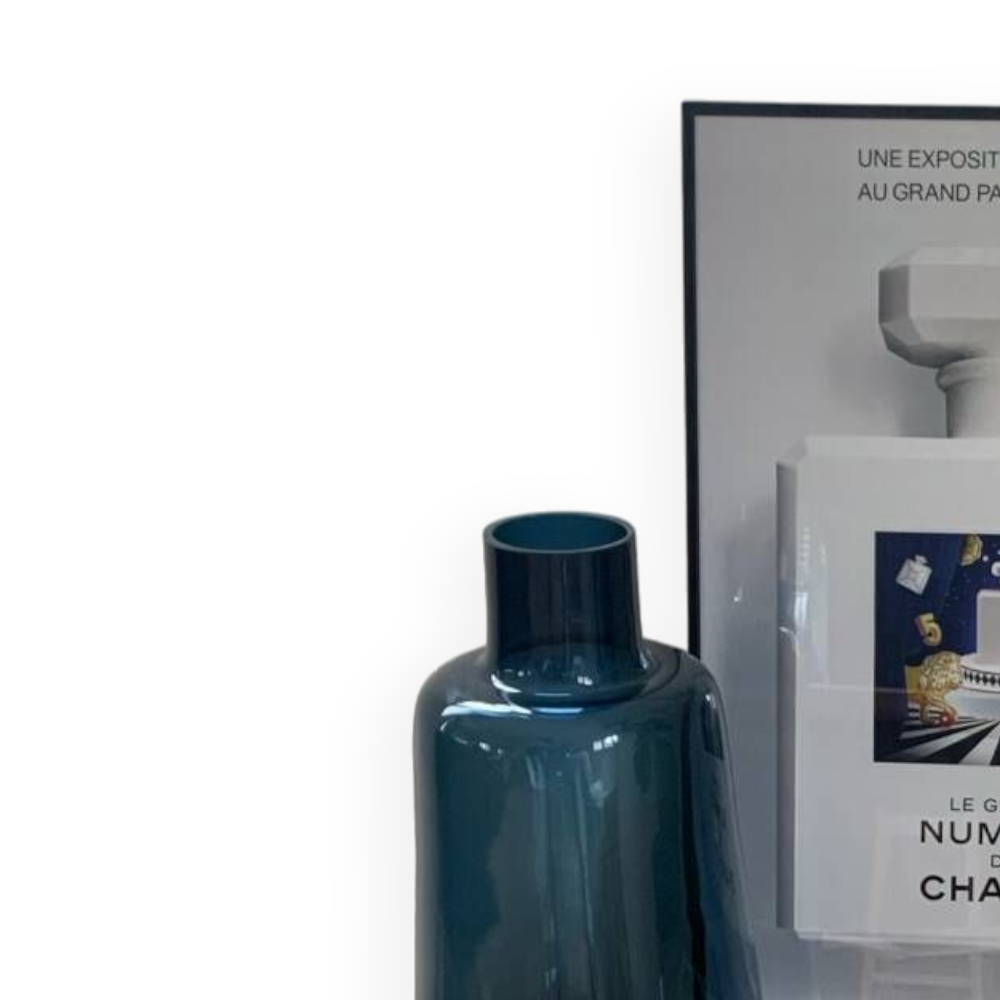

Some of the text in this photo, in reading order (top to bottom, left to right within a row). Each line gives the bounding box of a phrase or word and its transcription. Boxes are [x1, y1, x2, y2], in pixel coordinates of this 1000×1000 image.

[858, 149, 903, 168] UNE
[857, 183, 887, 201] AU
[892, 183, 970, 202] GRAND
[914, 612, 942, 645] 5
[950, 797, 974, 811] LE
